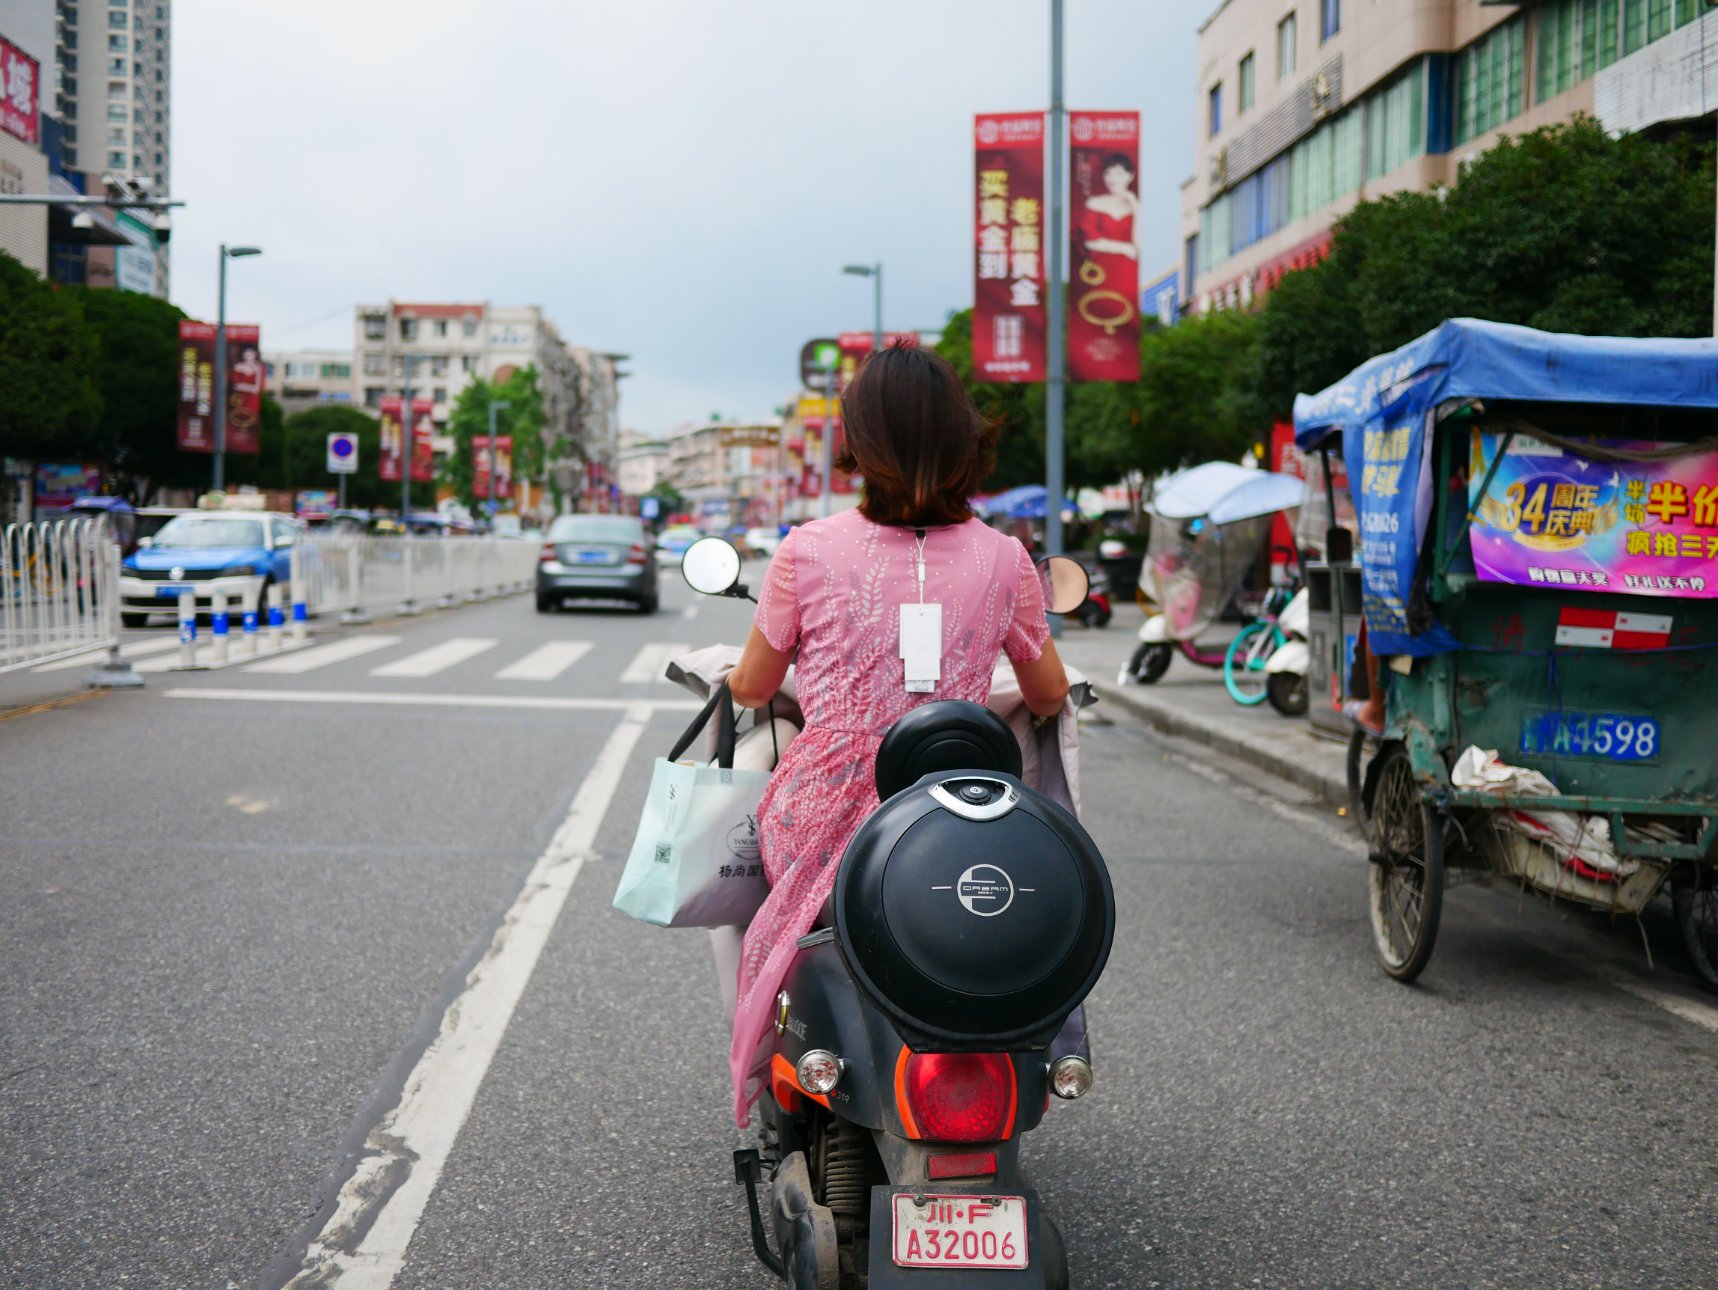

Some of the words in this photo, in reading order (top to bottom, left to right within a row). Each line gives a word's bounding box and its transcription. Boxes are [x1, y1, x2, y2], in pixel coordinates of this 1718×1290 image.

[1502, 482, 1548, 533] 34
[1552, 483, 1600, 509] 周年
[1543, 509, 1595, 536] 庆典
[906, 1228, 1016, 1260] A32006
